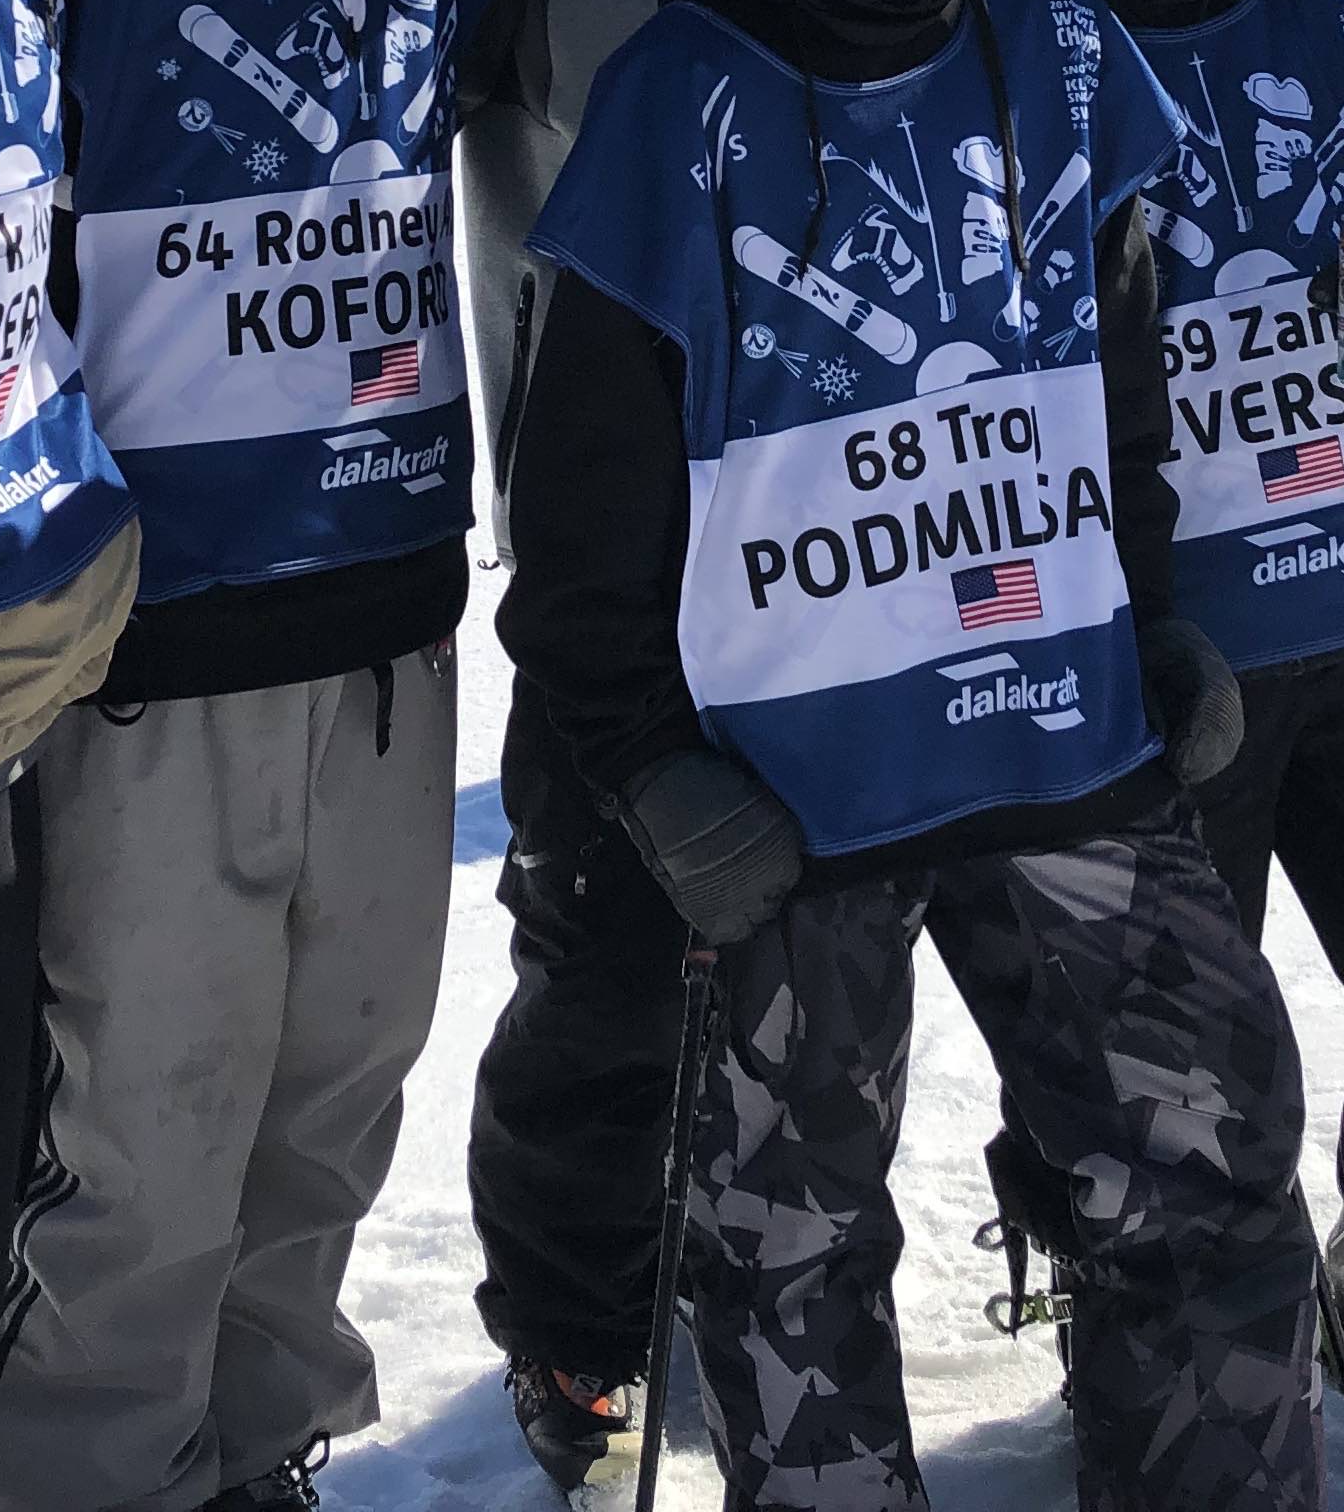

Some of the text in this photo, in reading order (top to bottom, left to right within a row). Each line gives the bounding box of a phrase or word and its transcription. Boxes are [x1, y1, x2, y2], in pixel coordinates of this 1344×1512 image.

[155, 219, 233, 279] 64
[255, 197, 438, 268] Rodney
[225, 261, 449, 357] KOFORD
[319, 435, 450, 492] dalakraft
[843, 419, 927, 492] 68
